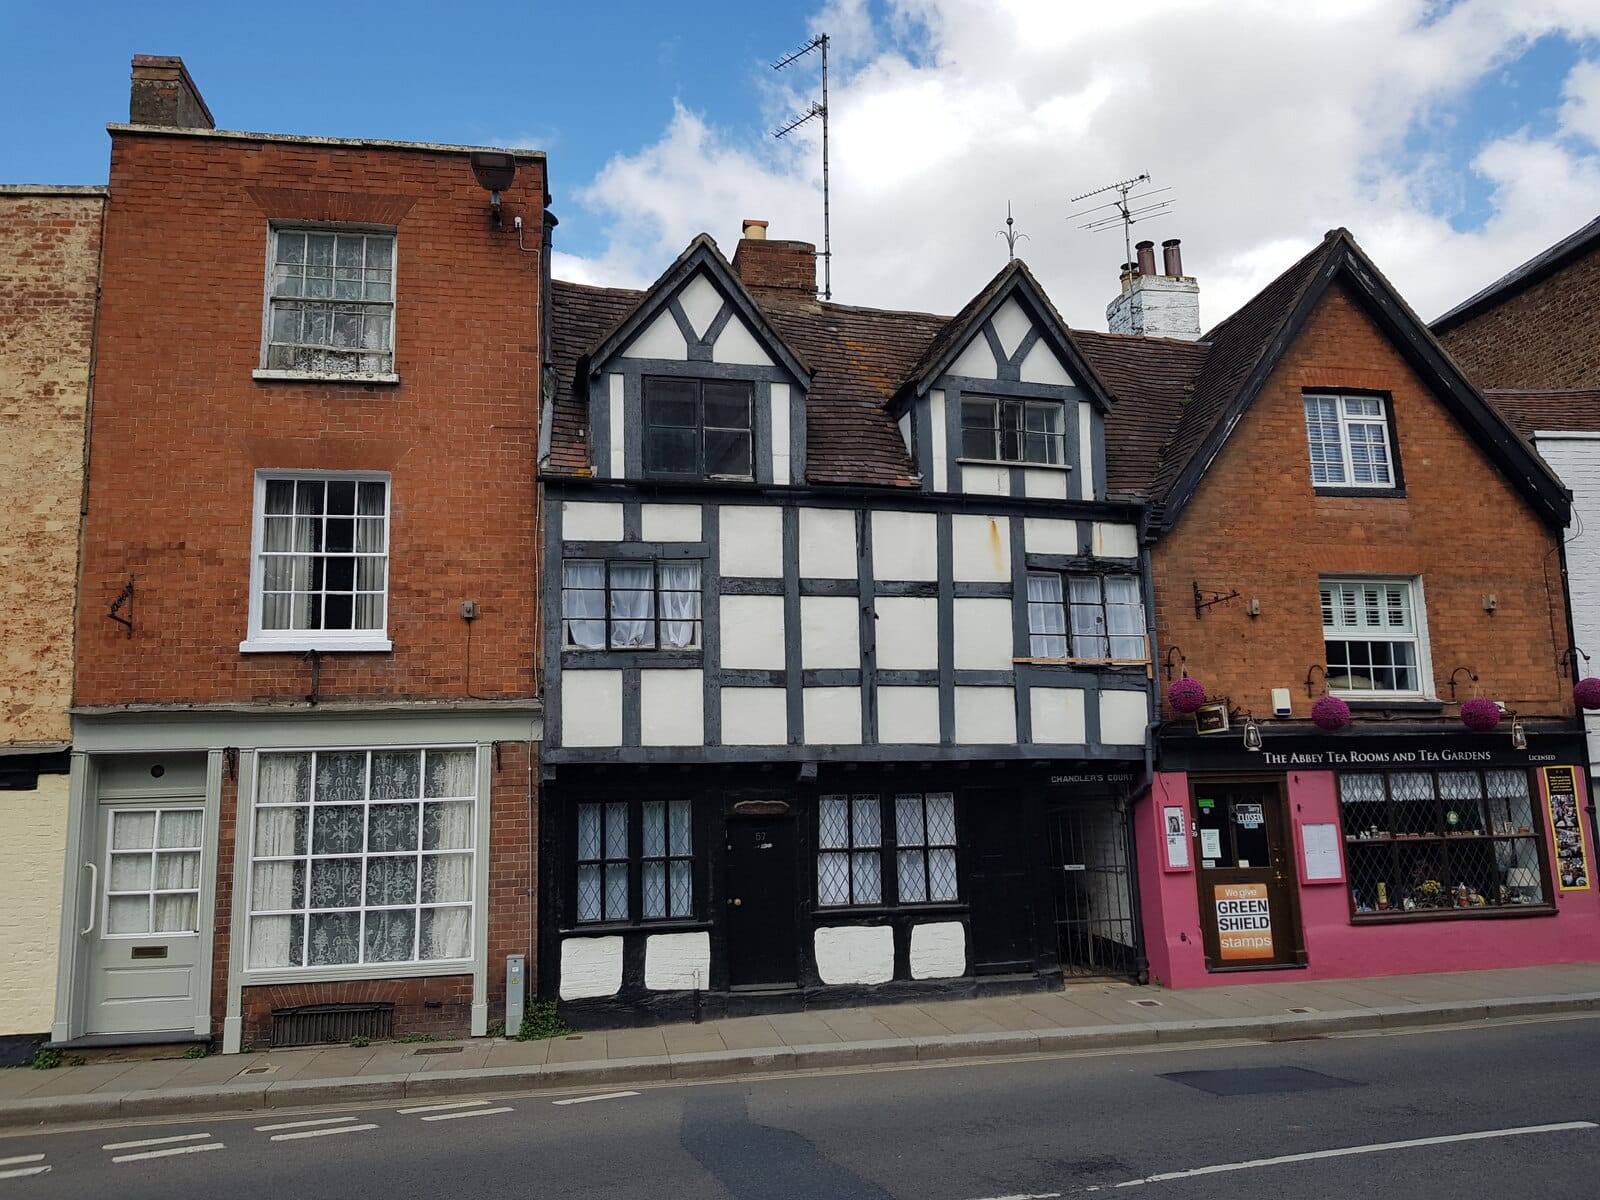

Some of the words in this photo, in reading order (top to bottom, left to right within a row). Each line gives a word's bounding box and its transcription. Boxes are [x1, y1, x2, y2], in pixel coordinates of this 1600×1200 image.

[1263, 752, 1288, 763] THE
[1290, 752, 1323, 763] ABBEY
[1326, 751, 1348, 762] TEA
[1349, 750, 1390, 762] ROOMS
[1392, 752, 1416, 762] AND
[1418, 750, 1439, 761] TEA
[1441, 749, 1491, 761] GARDENS
[1107, 773, 1135, 782] COURT
[1238, 813, 1263, 822] CLOSED
[1225, 889, 1238, 897] We
[1240, 889, 1257, 898] give
[1217, 900, 1268, 914] GREEN
[1219, 917, 1269, 931] SHIELD
[1221, 936, 1272, 949] stamps
